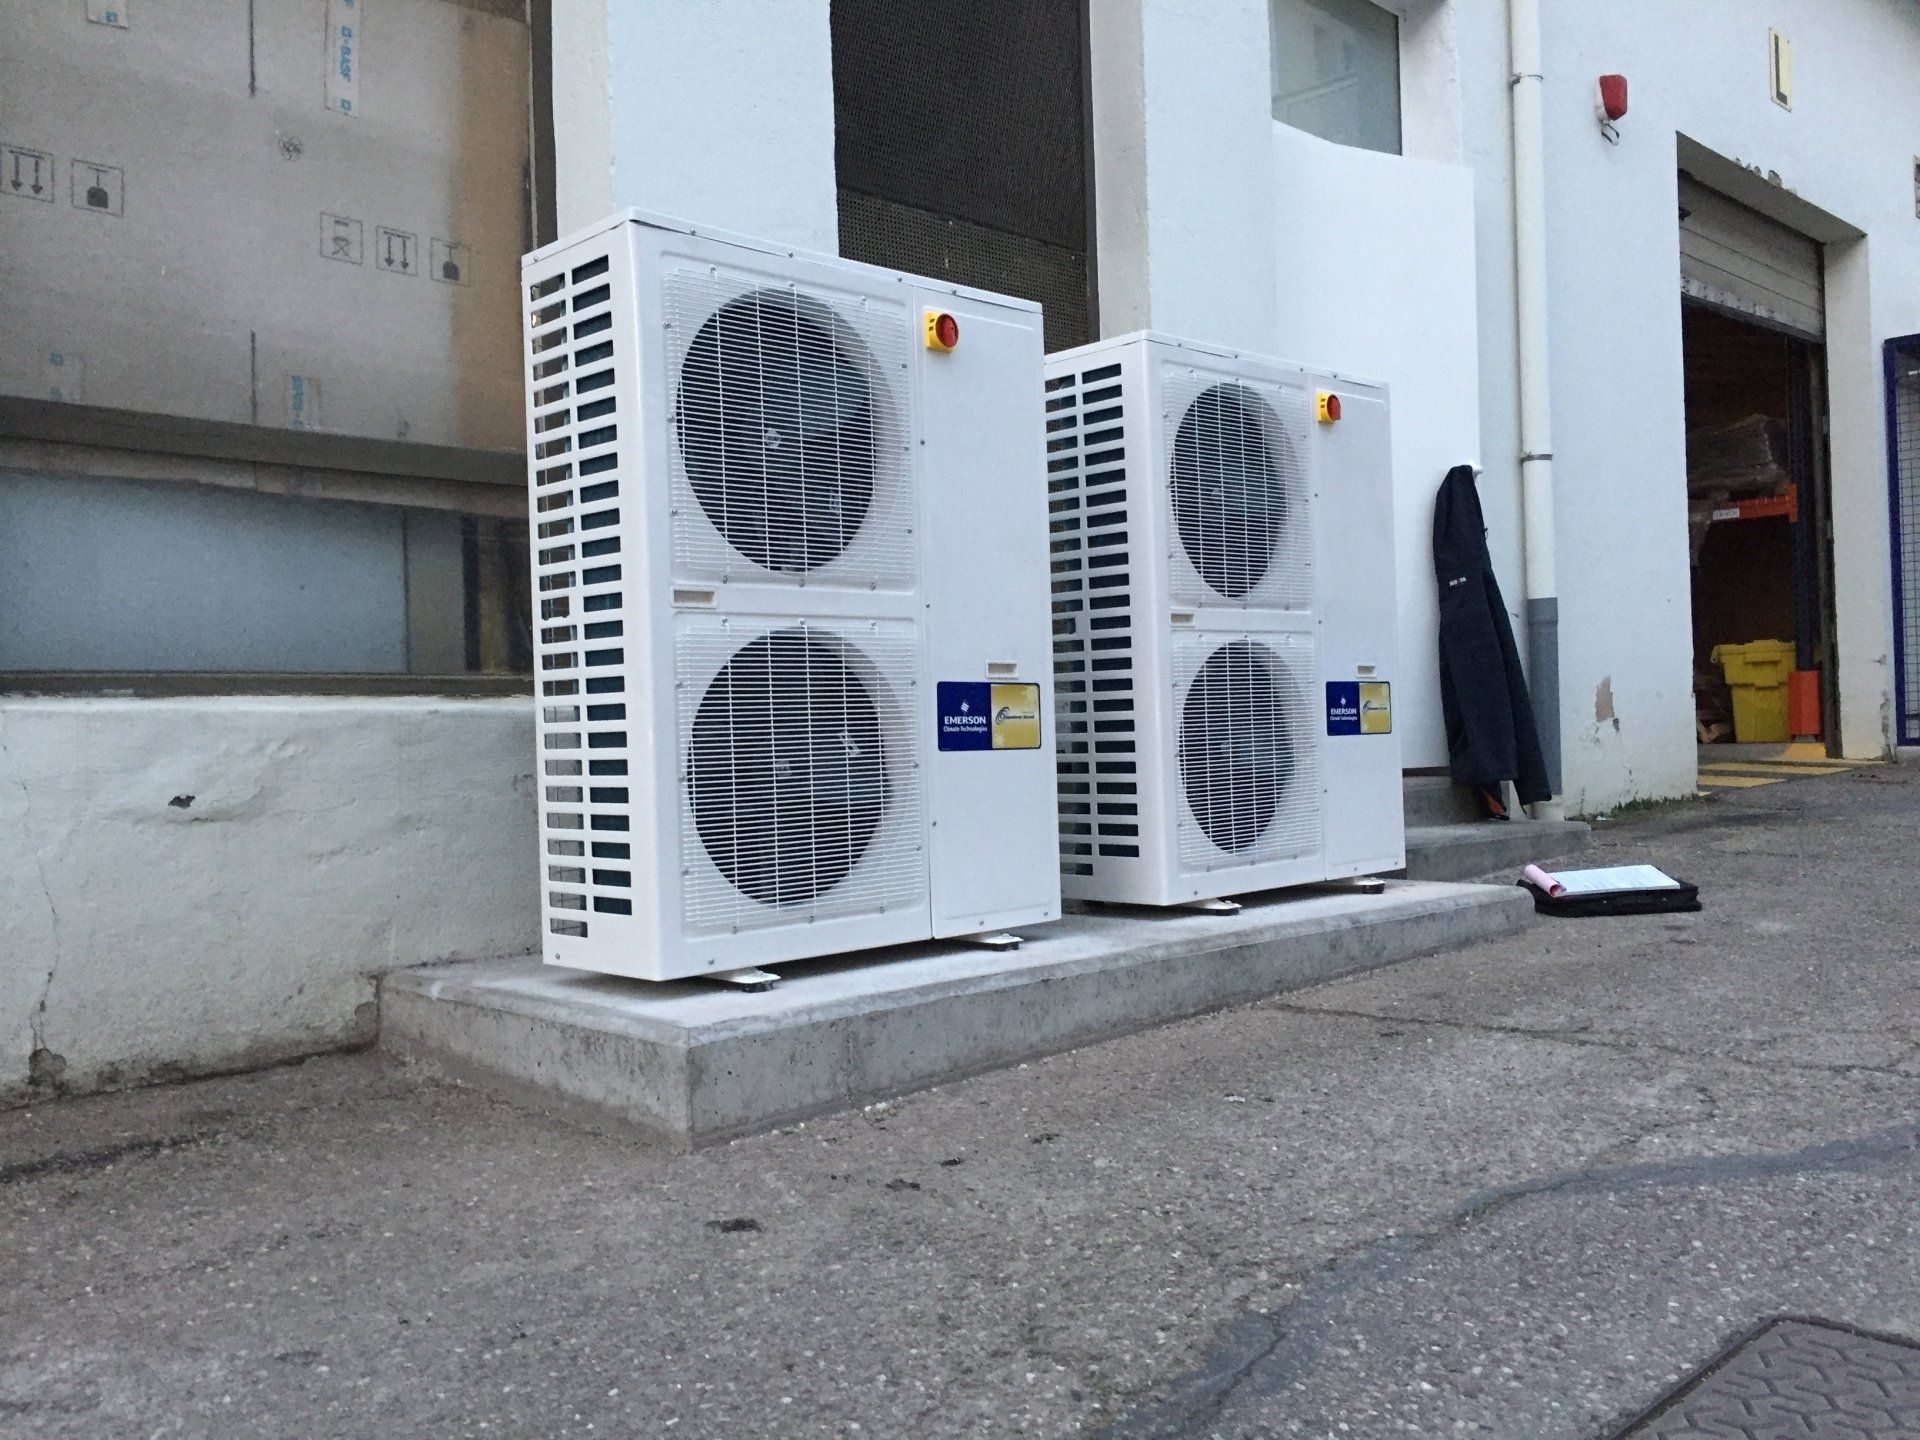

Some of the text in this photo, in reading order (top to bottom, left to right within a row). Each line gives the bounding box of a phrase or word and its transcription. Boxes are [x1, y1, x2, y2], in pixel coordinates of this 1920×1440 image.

[1774, 34, 1787, 105] L
[944, 716, 987, 725] EMERSON
[943, 725, 988, 734] Climate Technologies
